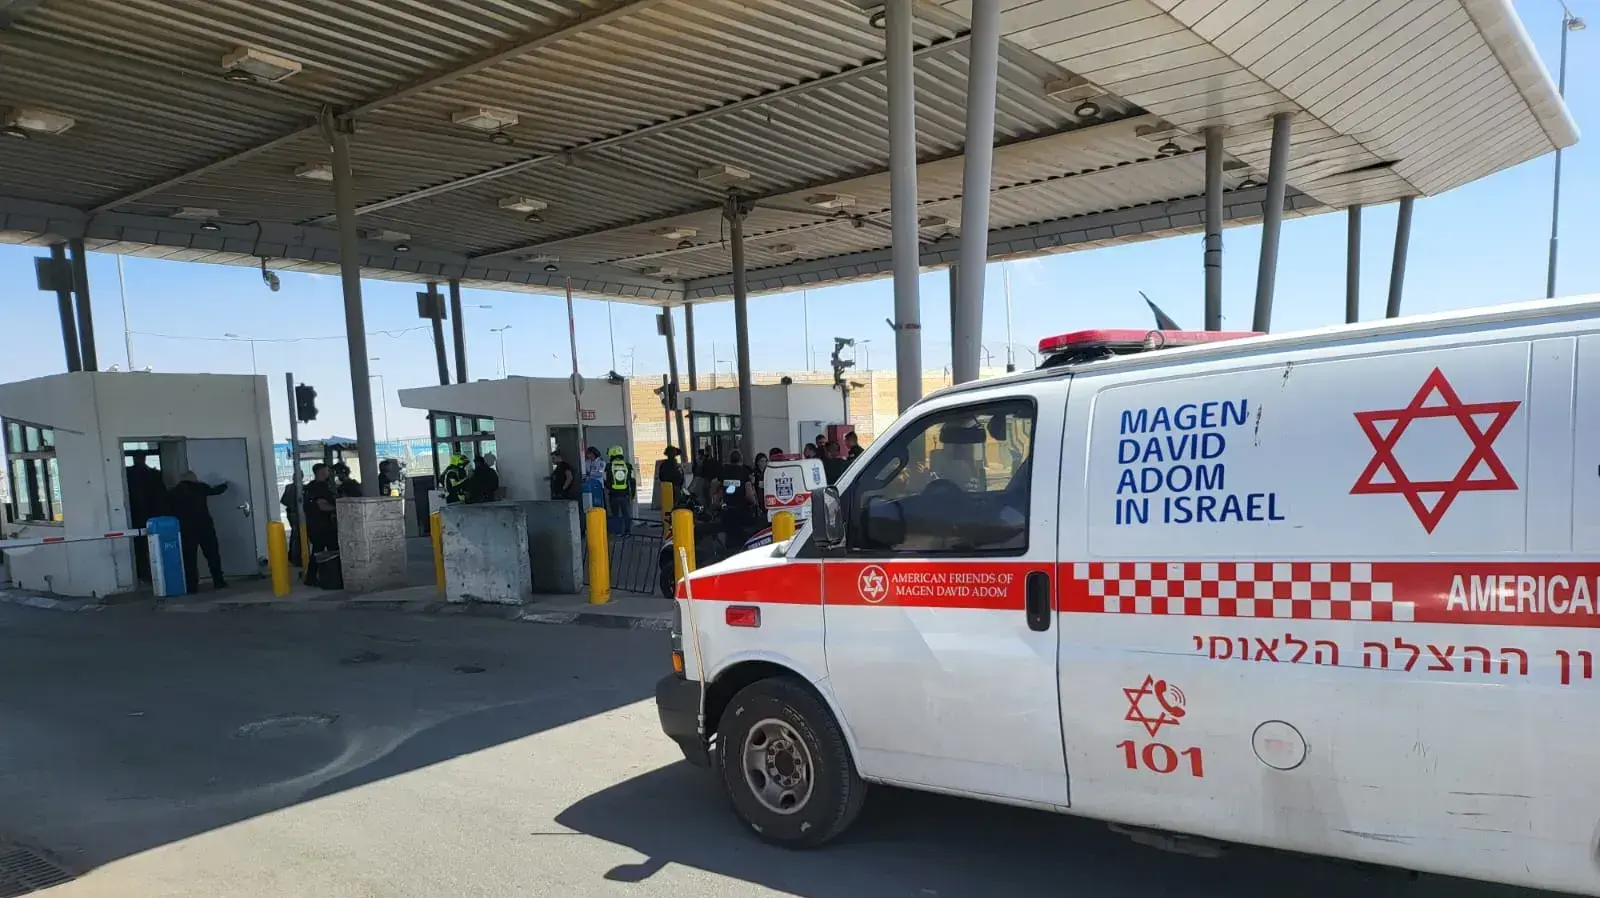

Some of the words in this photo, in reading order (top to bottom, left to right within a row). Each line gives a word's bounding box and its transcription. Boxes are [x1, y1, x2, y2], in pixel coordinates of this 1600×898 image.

[1120, 399, 1248, 434] MAGEN
[1118, 432, 1226, 464] DAVID
[1116, 463, 1225, 495] ADOM
[1115, 498, 1149, 525] IN
[1164, 493, 1285, 524] ISRAEL
[891, 573, 946, 584] AMERICAN
[949, 573, 996, 584] FRIENDS
[998, 573, 1013, 584] OF
[895, 586, 934, 596] MAGEN
[936, 587, 970, 597] DAVID
[971, 587, 1008, 597] ADOM
[1446, 574, 1600, 615] AMERICA
[1193, 633, 1339, 666] הלאומי
[1363, 637, 1529, 676] ההצלה
[1555, 649, 1593, 685] ון
[1116, 740, 1204, 778] 101
